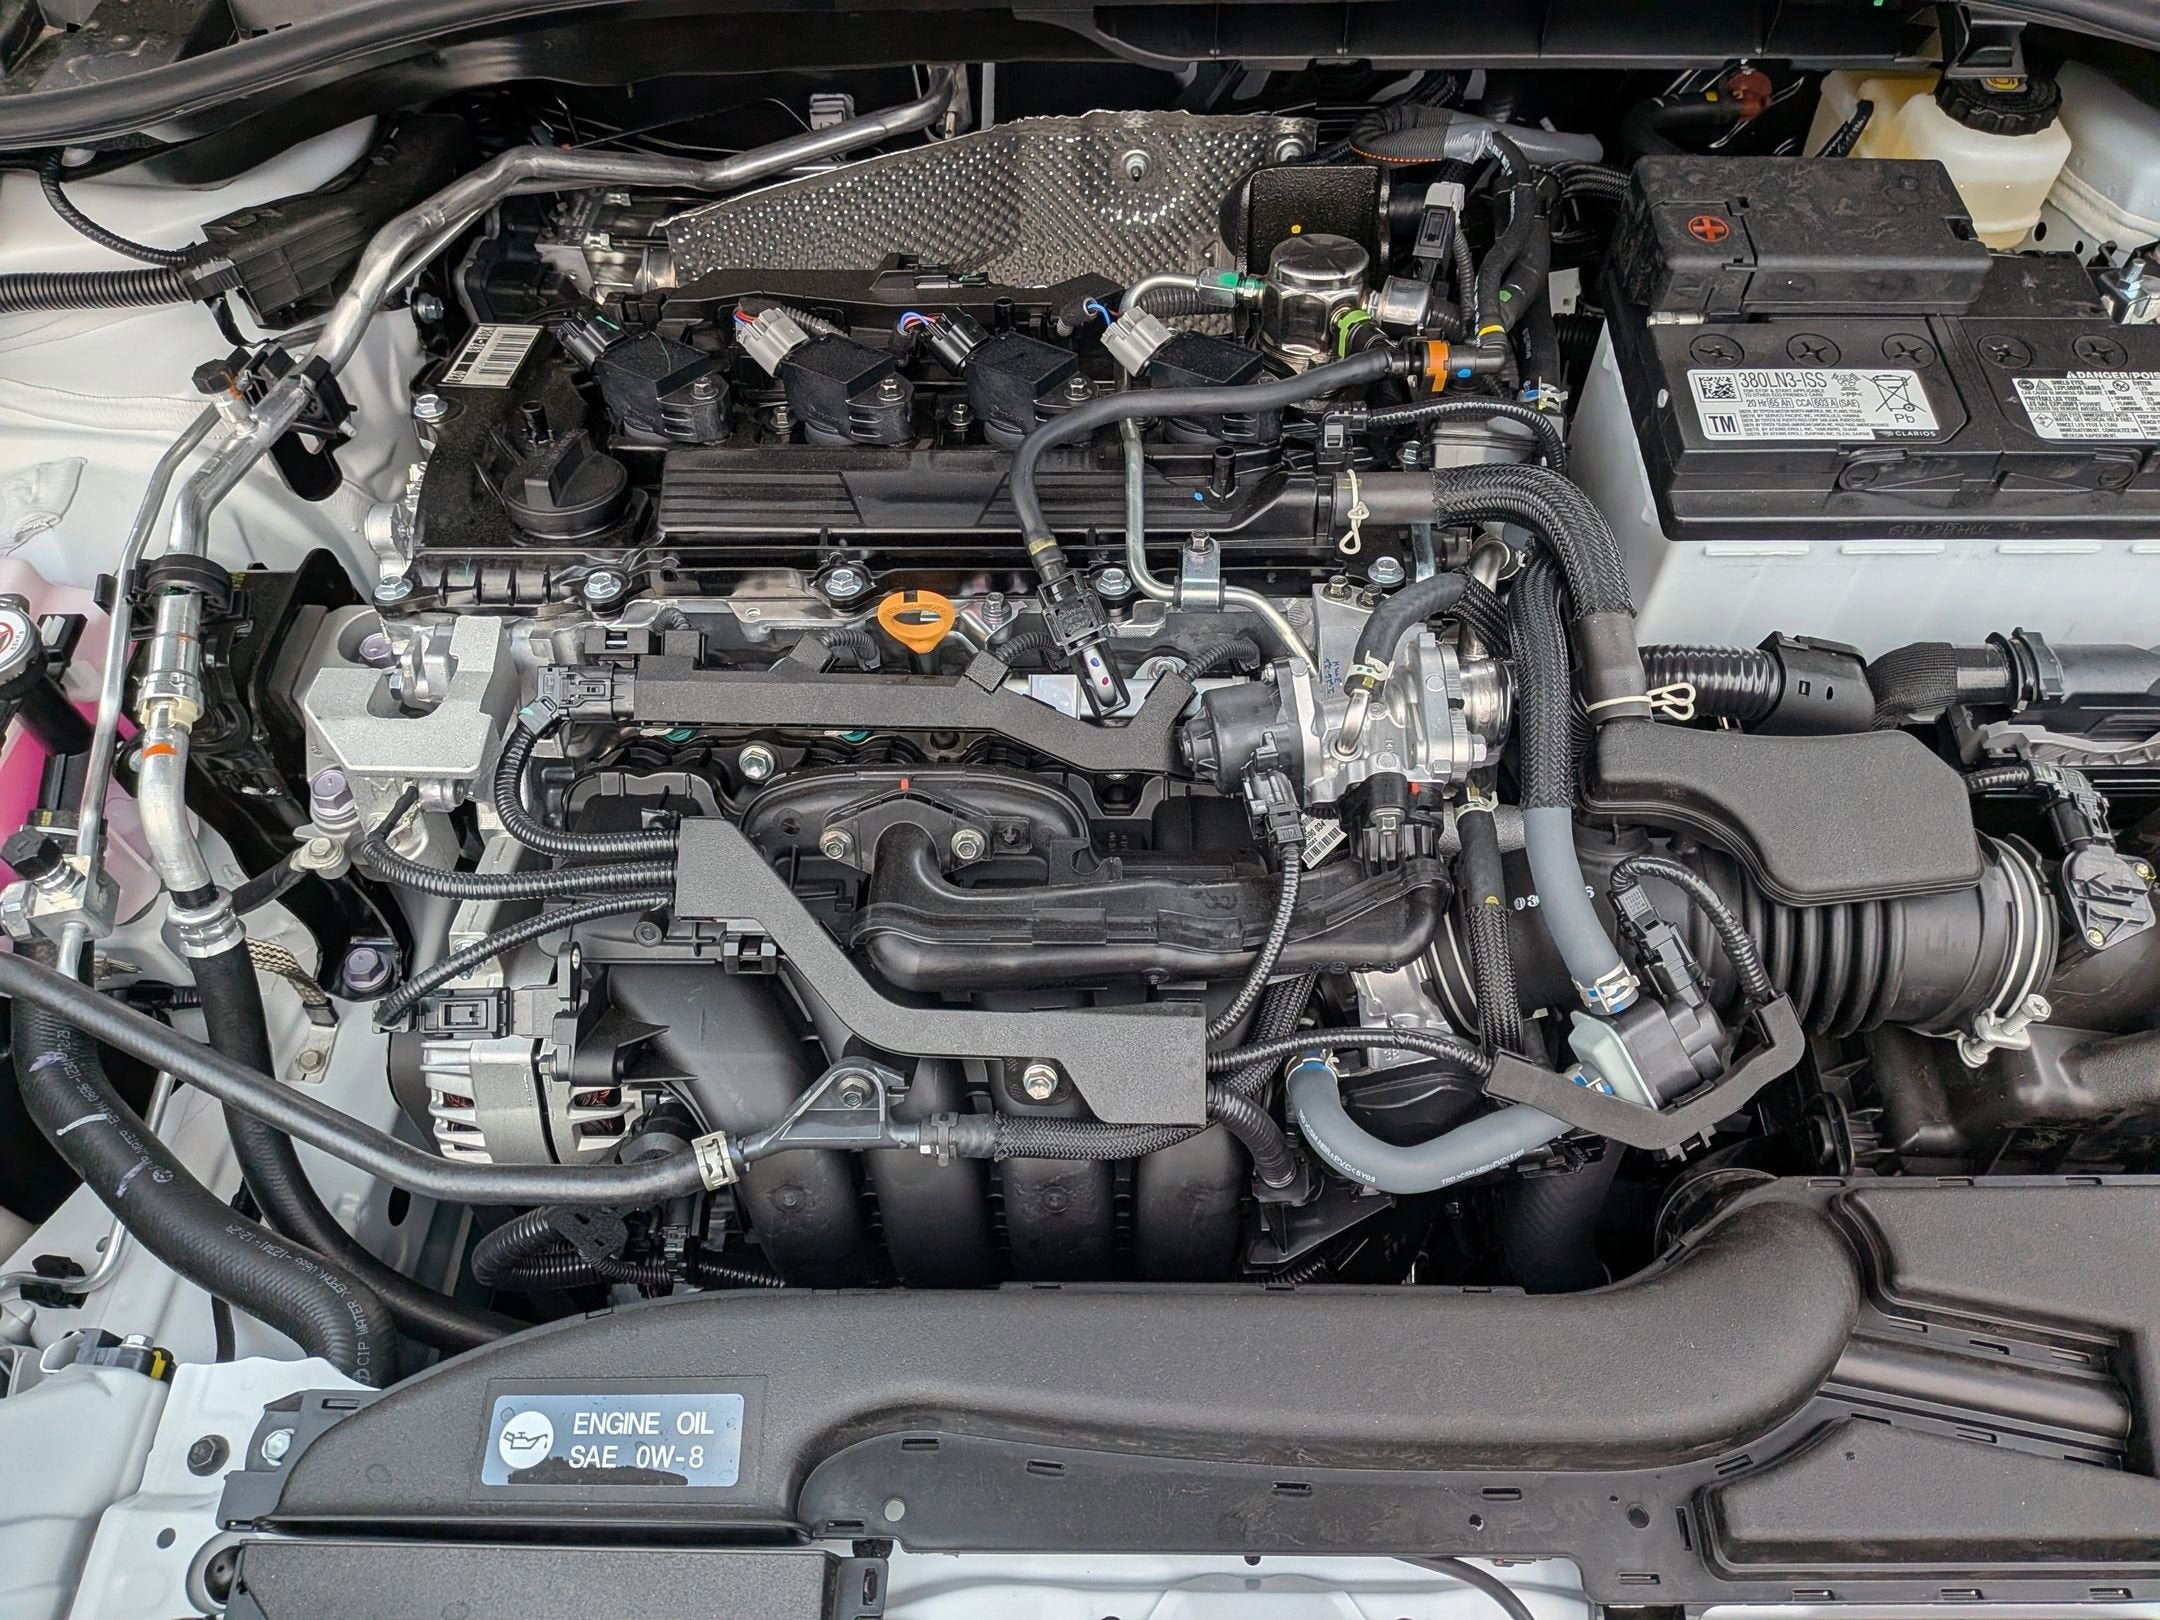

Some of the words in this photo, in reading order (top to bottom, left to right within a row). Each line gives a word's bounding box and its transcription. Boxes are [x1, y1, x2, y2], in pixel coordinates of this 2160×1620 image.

[1739, 372, 1827, 387] 380LN3-ISS
[1746, 399, 1756, 407] 20
[1758, 399, 1767, 407] Hr
[1770, 399, 1779, 407] 65
[1781, 399, 1791, 407] Ah
[1796, 399, 1812, 407] CCA
[1814, 399, 1828, 407] 603
[1708, 416, 1737, 432] TM
[1894, 414, 1915, 424] Pb
[346, 1300, 368, 1336] WATER
[572, 1412, 660, 1435] ENGINE
[676, 1412, 714, 1434] OIL
[568, 1446, 618, 1468] SAE
[636, 1446, 704, 1468] 0W-8
